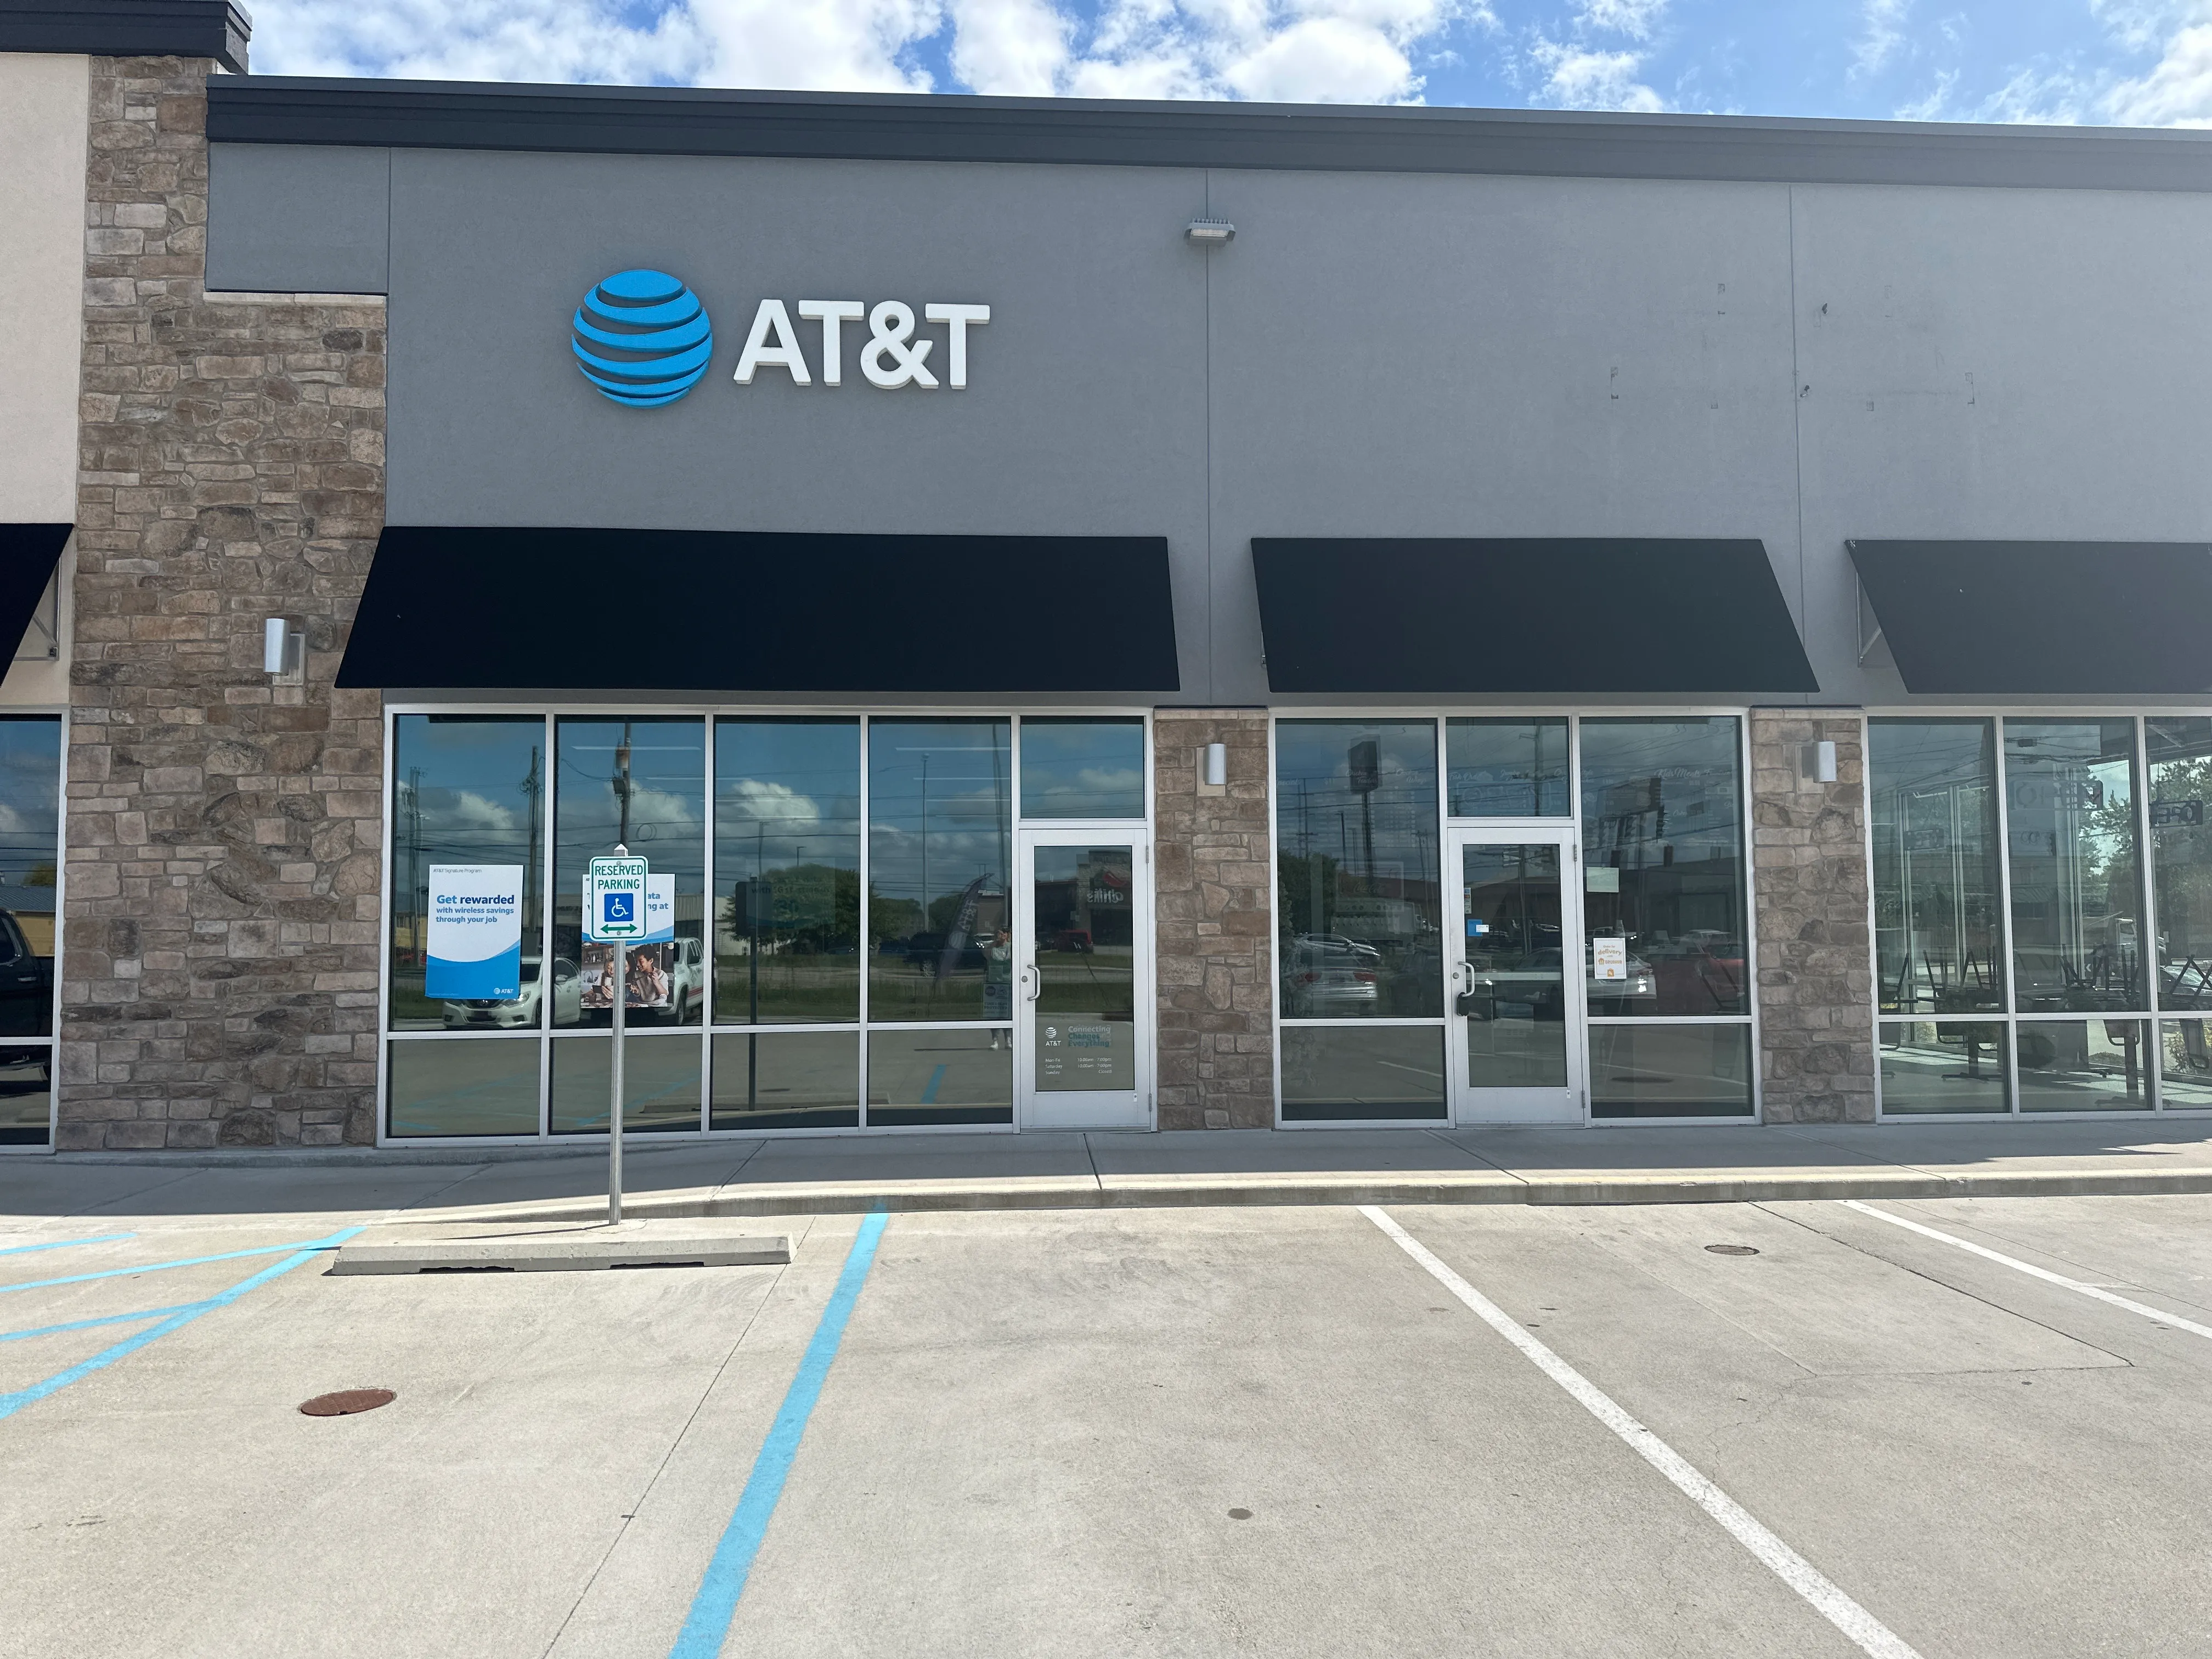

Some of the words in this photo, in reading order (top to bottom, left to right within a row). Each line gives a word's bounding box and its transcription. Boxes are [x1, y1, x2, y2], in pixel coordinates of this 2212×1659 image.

[733, 299, 990, 390] AT&T
[595, 865, 644, 876] RESERVED
[598, 879, 640, 889] PARKING
[436, 895, 457, 904] Get
[460, 895, 515, 904] rewarded
[485, 916, 498, 924] job
[1068, 1025, 1111, 1034] Connecting
[1068, 1039, 1110, 1048] Everything
